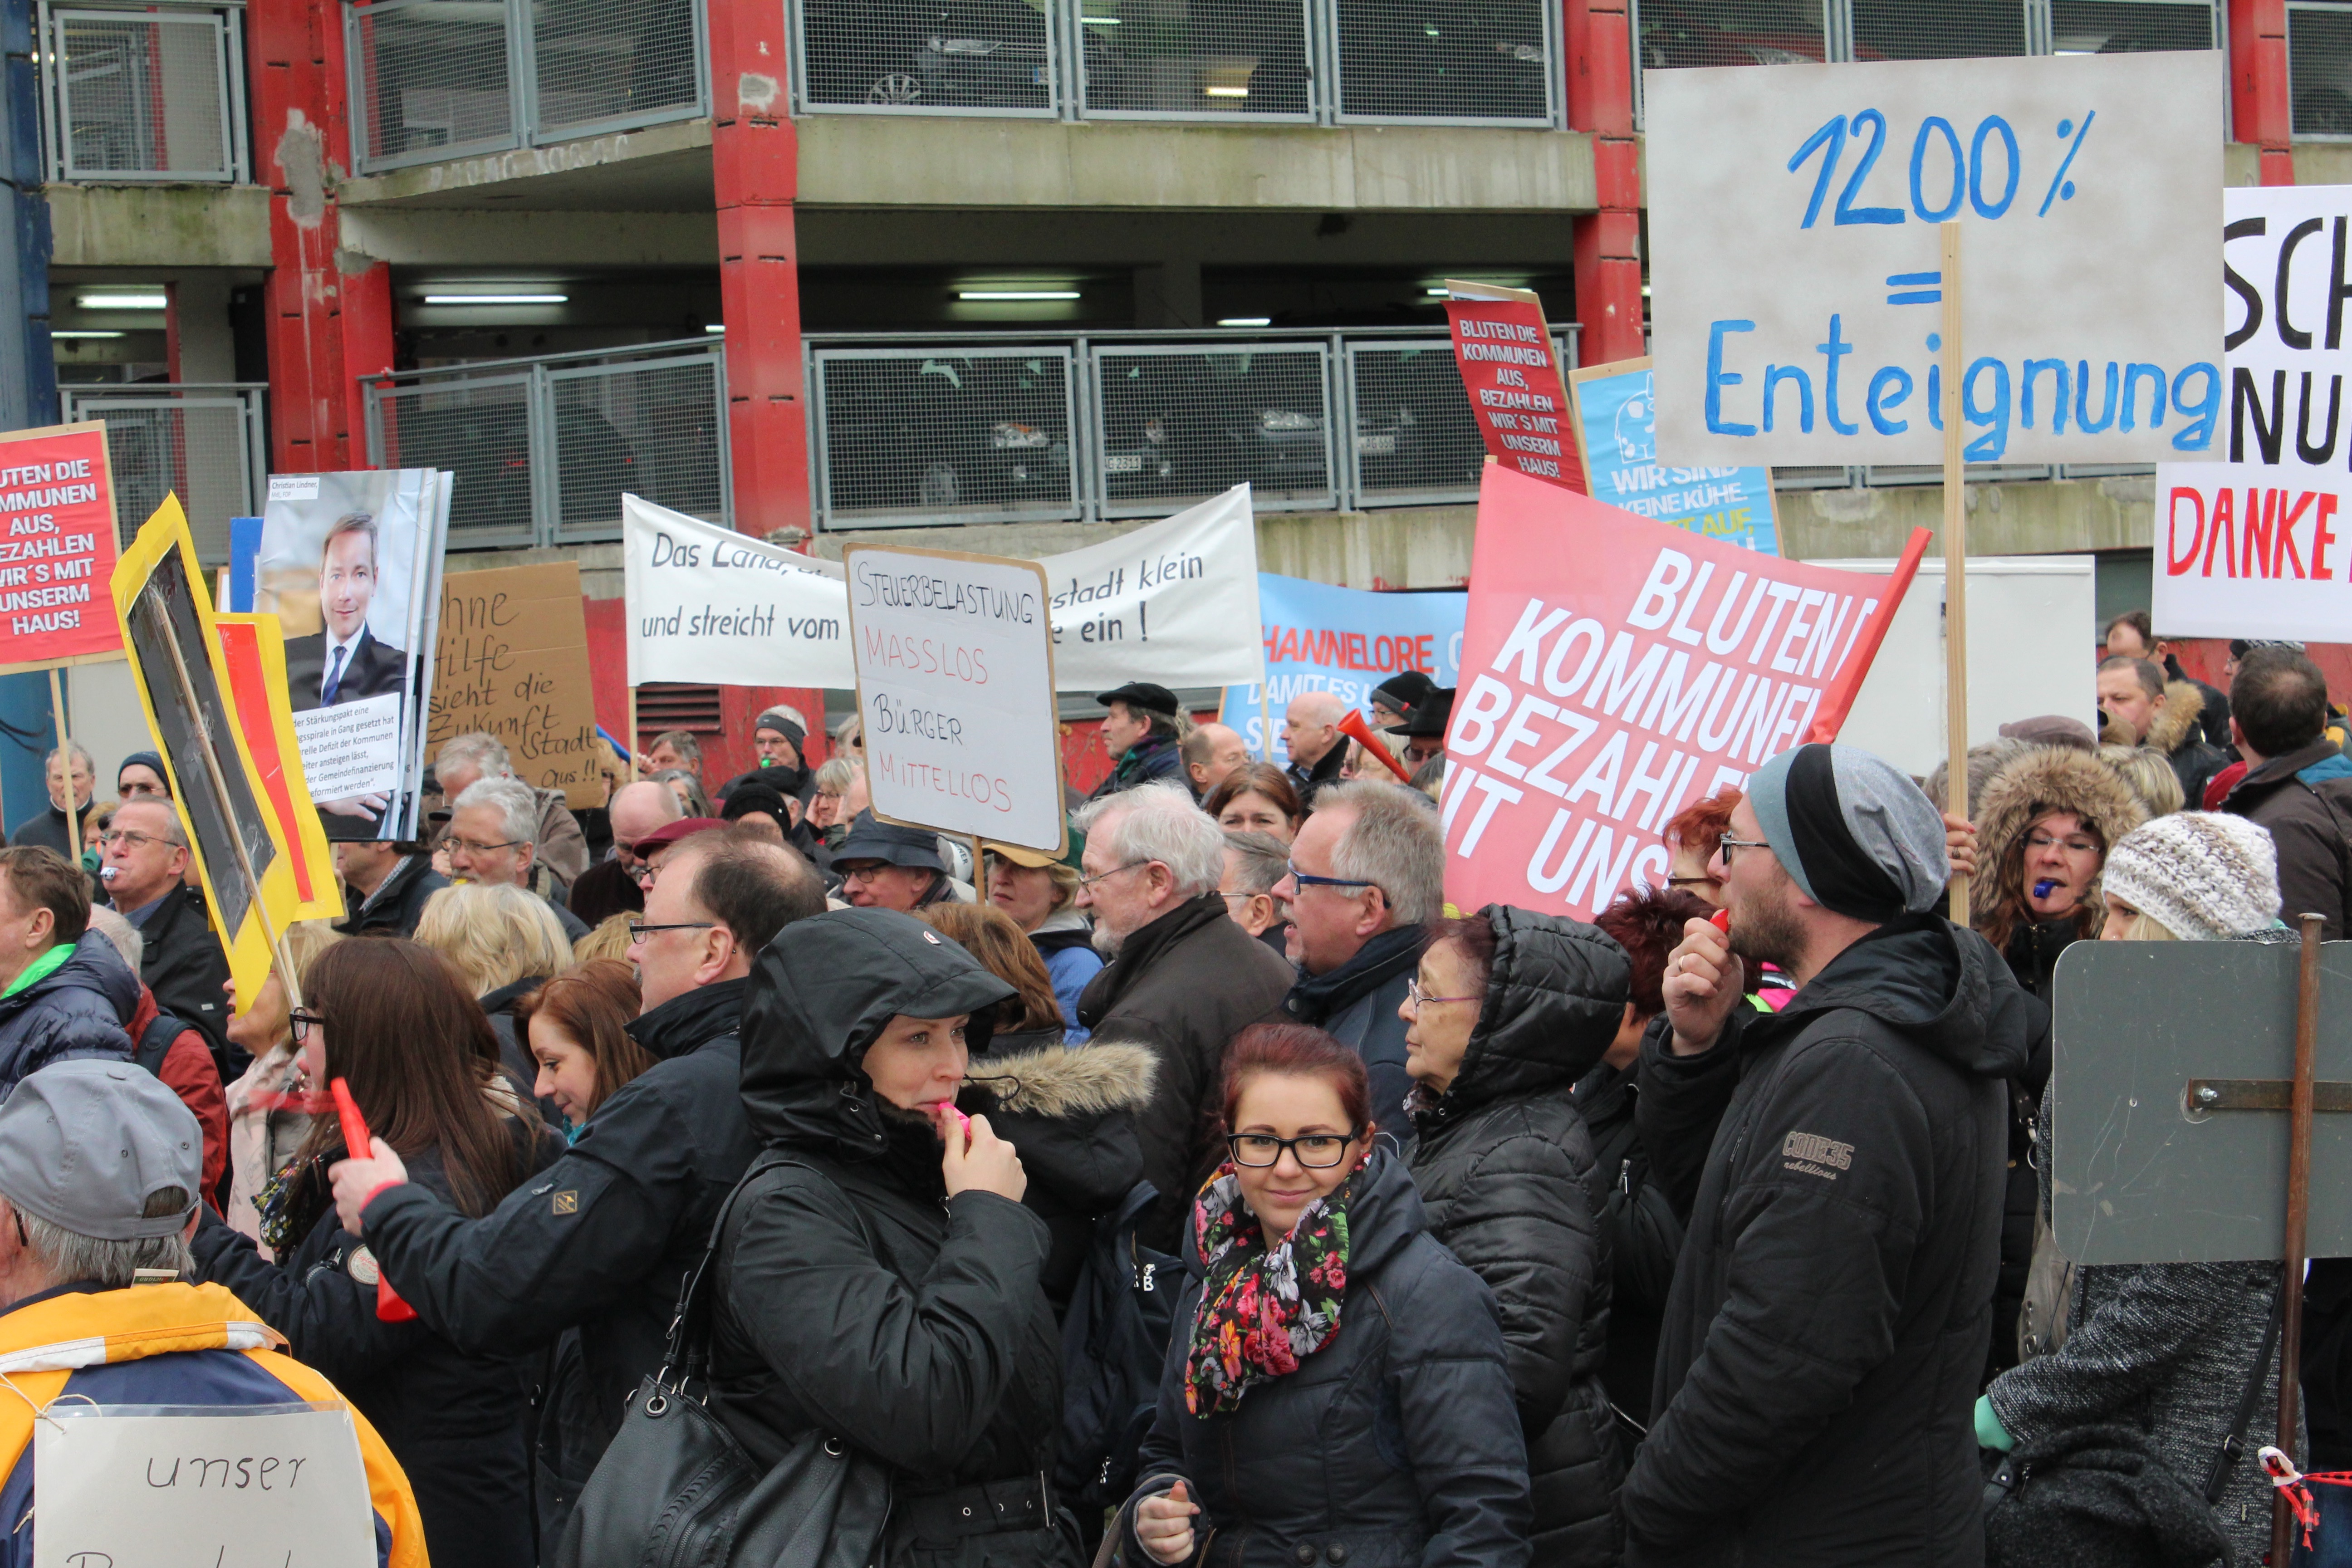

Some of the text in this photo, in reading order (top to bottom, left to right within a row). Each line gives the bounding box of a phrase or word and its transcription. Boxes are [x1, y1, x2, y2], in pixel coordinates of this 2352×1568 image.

[1788, 107, 2095, 230] 1200 %
[1459, 319, 1540, 344] BLUTEN DIE
[1461, 343, 1547, 368] KOMMUNEN
[1497, 368, 1529, 391] AUS,
[1704, 313, 2221, 462] Enteignung
[1479, 388, 1555, 412] BEZAHLEN
[1531, 416, 1558, 435] MIT
[1500, 434, 1561, 457] UNSERM
[55, 459, 91, 480] DIE
[1517, 456, 1561, 478] HAUS!
[1611, 464, 1668, 495] WIR
[272, 481, 295, 490] Christian
[1683, 481, 1748, 511] KÜHE.
[9, 513, 60, 537] AUS,
[1701, 507, 1754, 537] AUF,
[2166, 486, 2338, 580] DANKE
[54, 558, 95, 580] MIT
[651, 533, 699, 568] Das
[1049, 568, 1124, 610] stadt
[1137, 552, 1203, 591] klein
[858, 561, 1034, 625] STEUERBELASTUNG
[12, 609, 81, 635] HAUS!
[642, 605, 682, 638] und
[688, 604, 775, 637] streicht
[788, 617, 839, 641] vom
[1081, 612, 1123, 643] ein
[1626, 547, 1853, 679] BLUTEN
[865, 624, 989, 685] MASSLOS
[429, 672, 555, 713] sieht die
[306, 709, 353, 726] Stärkungspakt
[354, 706, 369, 716] eine
[331, 727, 337, 735] in
[338, 724, 354, 734] Gang
[356, 718, 381, 732] gesetzt
[382, 715, 394, 725] hat
[299, 731, 393, 756] relle Defizit der Kommunen
[521, 725, 598, 760] Stadt
[318, 760, 394, 783] Gemeindefinanzierung
[319, 754, 350, 768] ansteigen
[351, 750, 369, 761] lässt,
[541, 769, 577, 789] aus
[147, 1457, 306, 1490] unser
